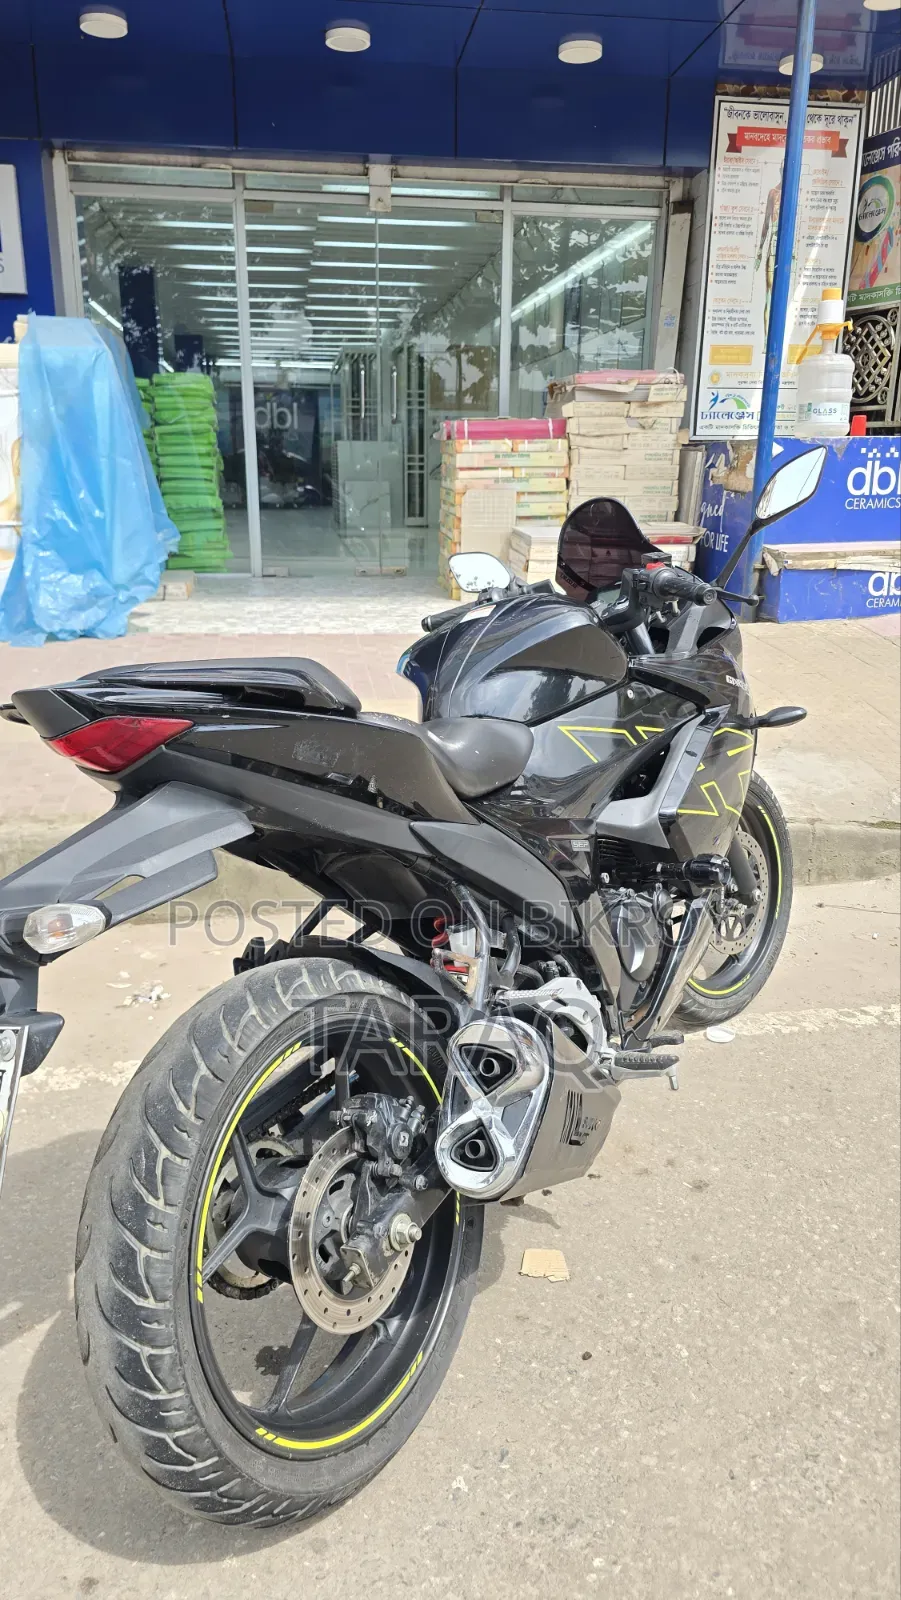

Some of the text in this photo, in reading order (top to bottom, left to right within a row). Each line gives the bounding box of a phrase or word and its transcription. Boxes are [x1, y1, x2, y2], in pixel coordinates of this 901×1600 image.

[845, 497, 901, 510] CERAMICS
[715, 532, 729, 553] LIFE
[866, 597, 901, 608] CERAM
